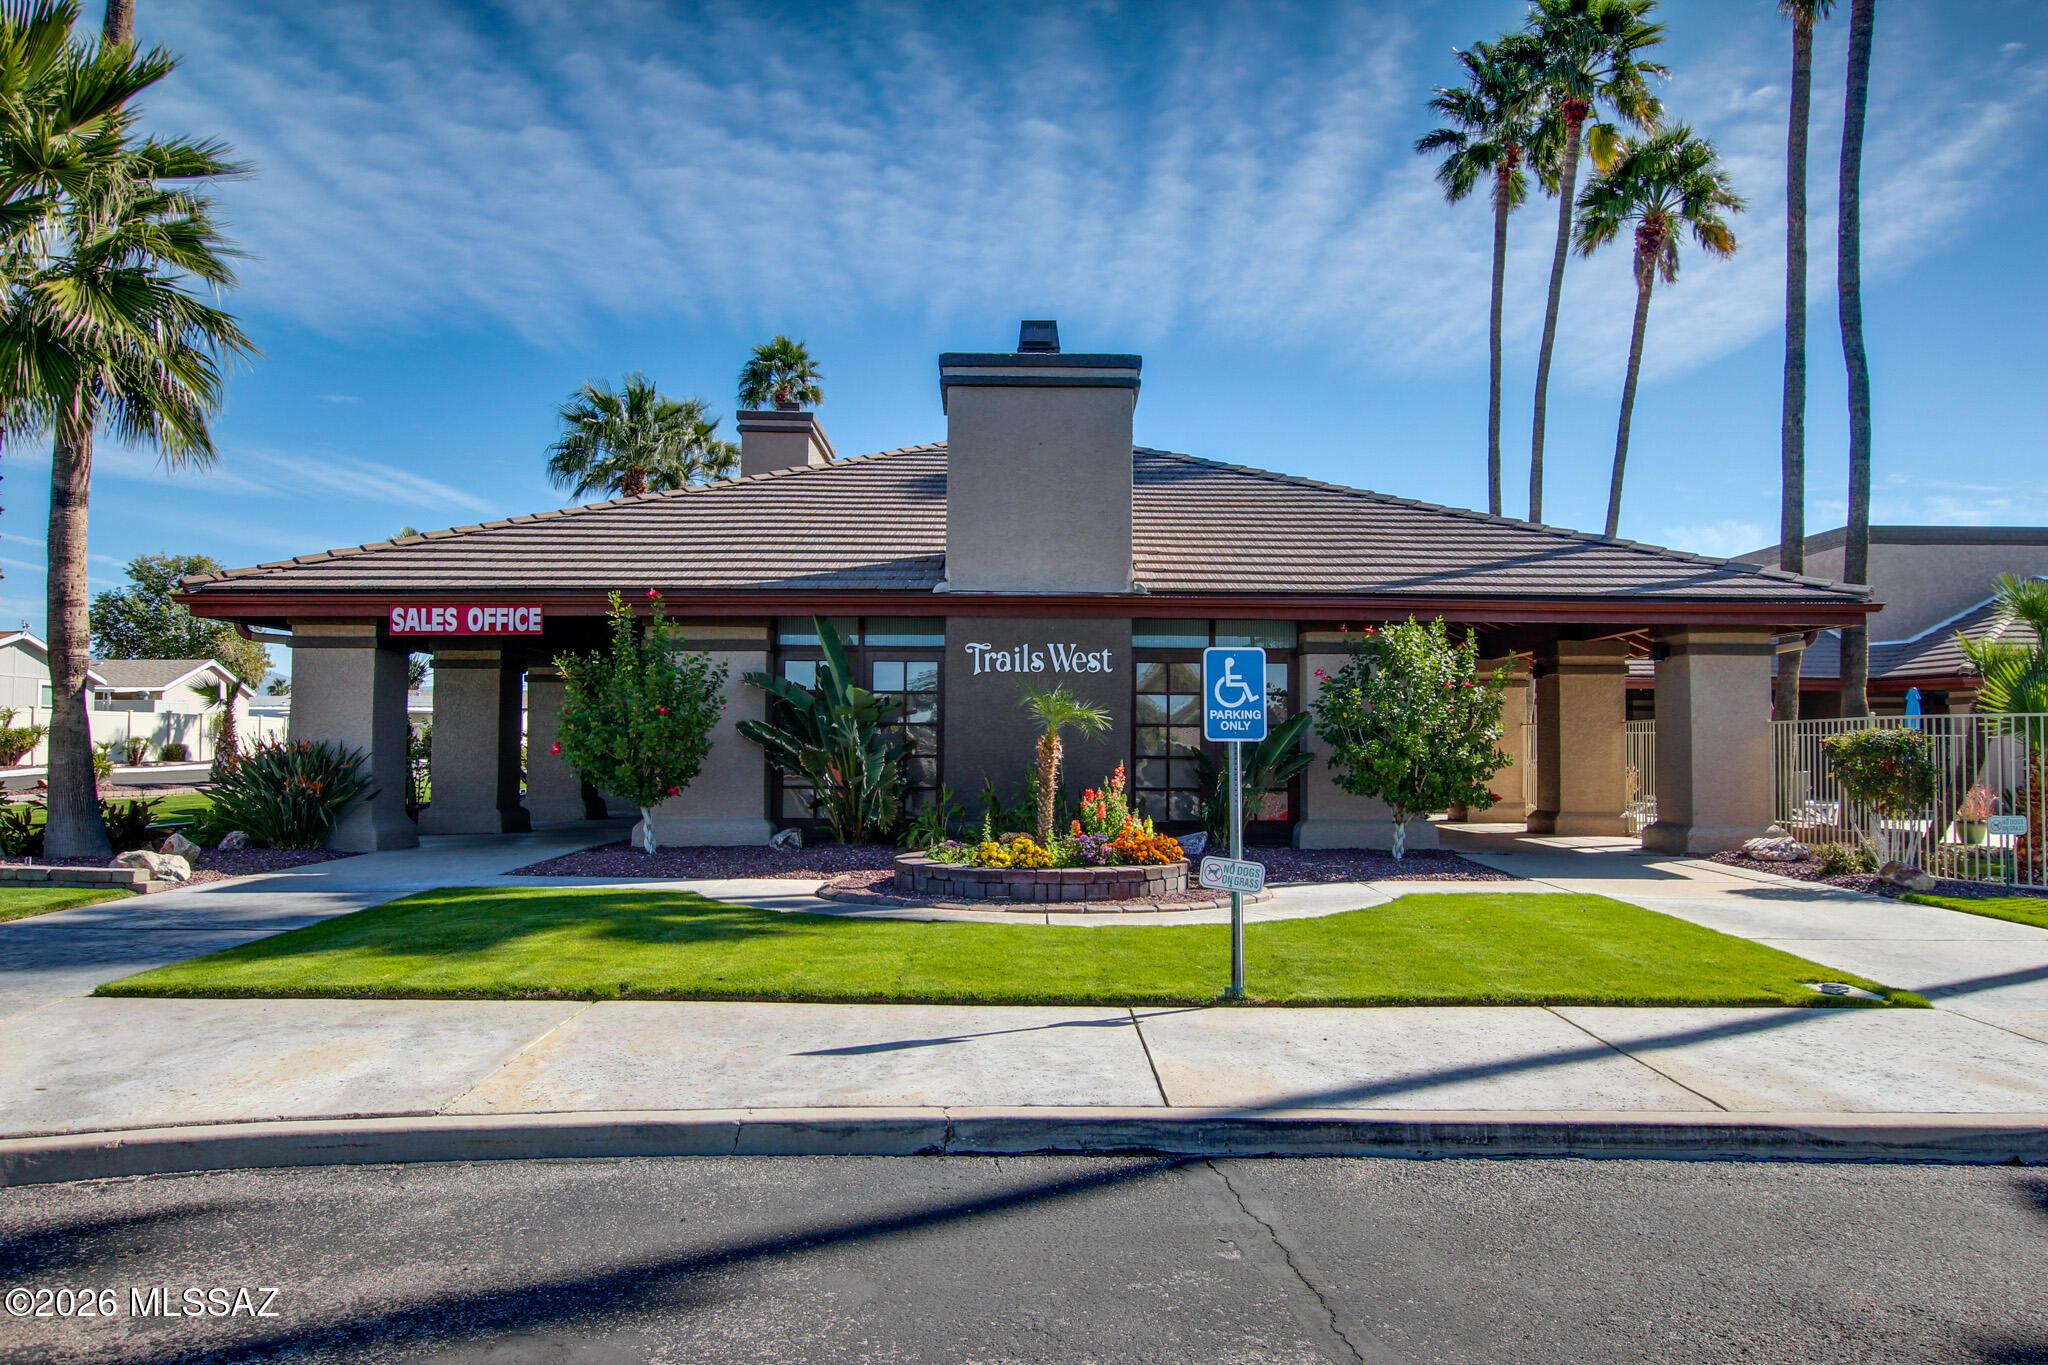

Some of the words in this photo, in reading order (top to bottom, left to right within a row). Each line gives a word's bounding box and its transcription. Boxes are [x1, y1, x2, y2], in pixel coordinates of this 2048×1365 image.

[392, 607, 458, 632] SALES
[467, 607, 542, 632] OFFICE
[964, 642, 1045, 676] Trails
[1047, 643, 1114, 673] West
[1210, 710, 1261, 719] PARKING
[1220, 721, 1251, 731] ONLY
[1223, 864, 1235, 875] NO
[1237, 866, 1261, 878] DOGS
[1222, 875, 1233, 884] ON
[1234, 876, 1259, 889] GRASS
